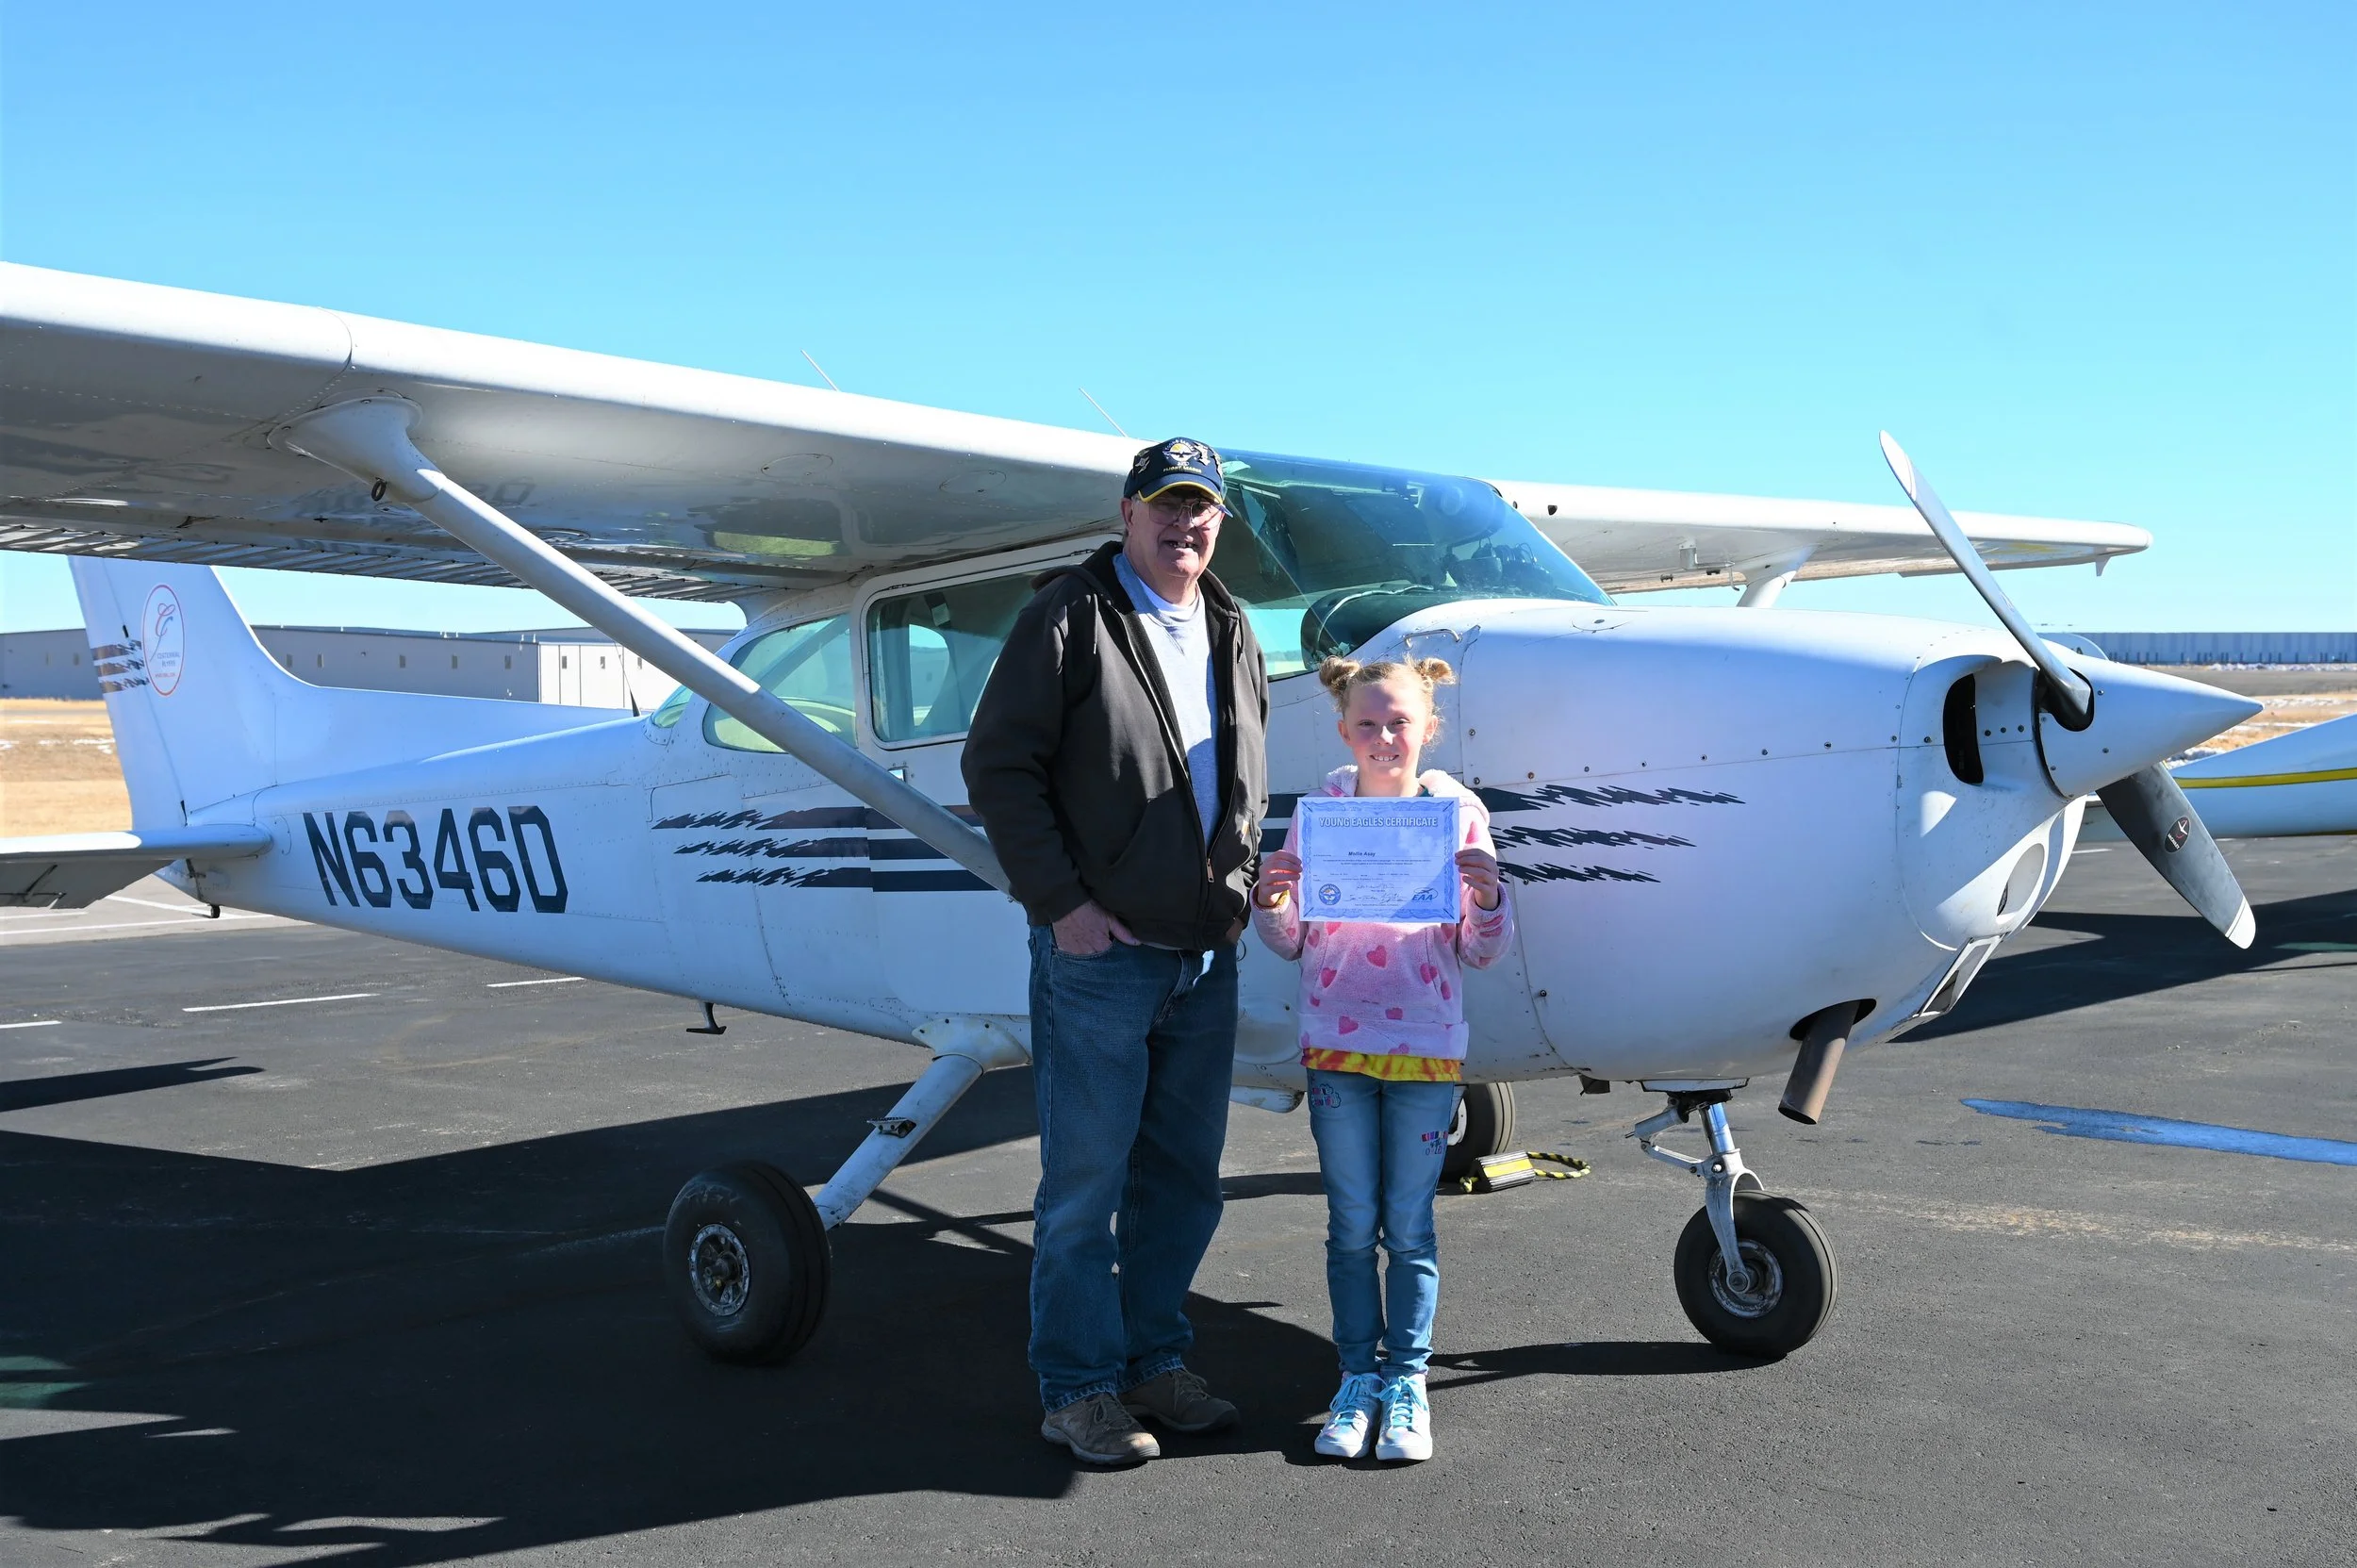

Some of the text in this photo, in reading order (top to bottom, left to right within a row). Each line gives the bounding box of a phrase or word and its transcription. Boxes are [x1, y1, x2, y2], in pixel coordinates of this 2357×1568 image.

[1319, 817, 1438, 828] YOUNG EAGLES CERTIFICATE
[303, 805, 569, 914] N6346D
